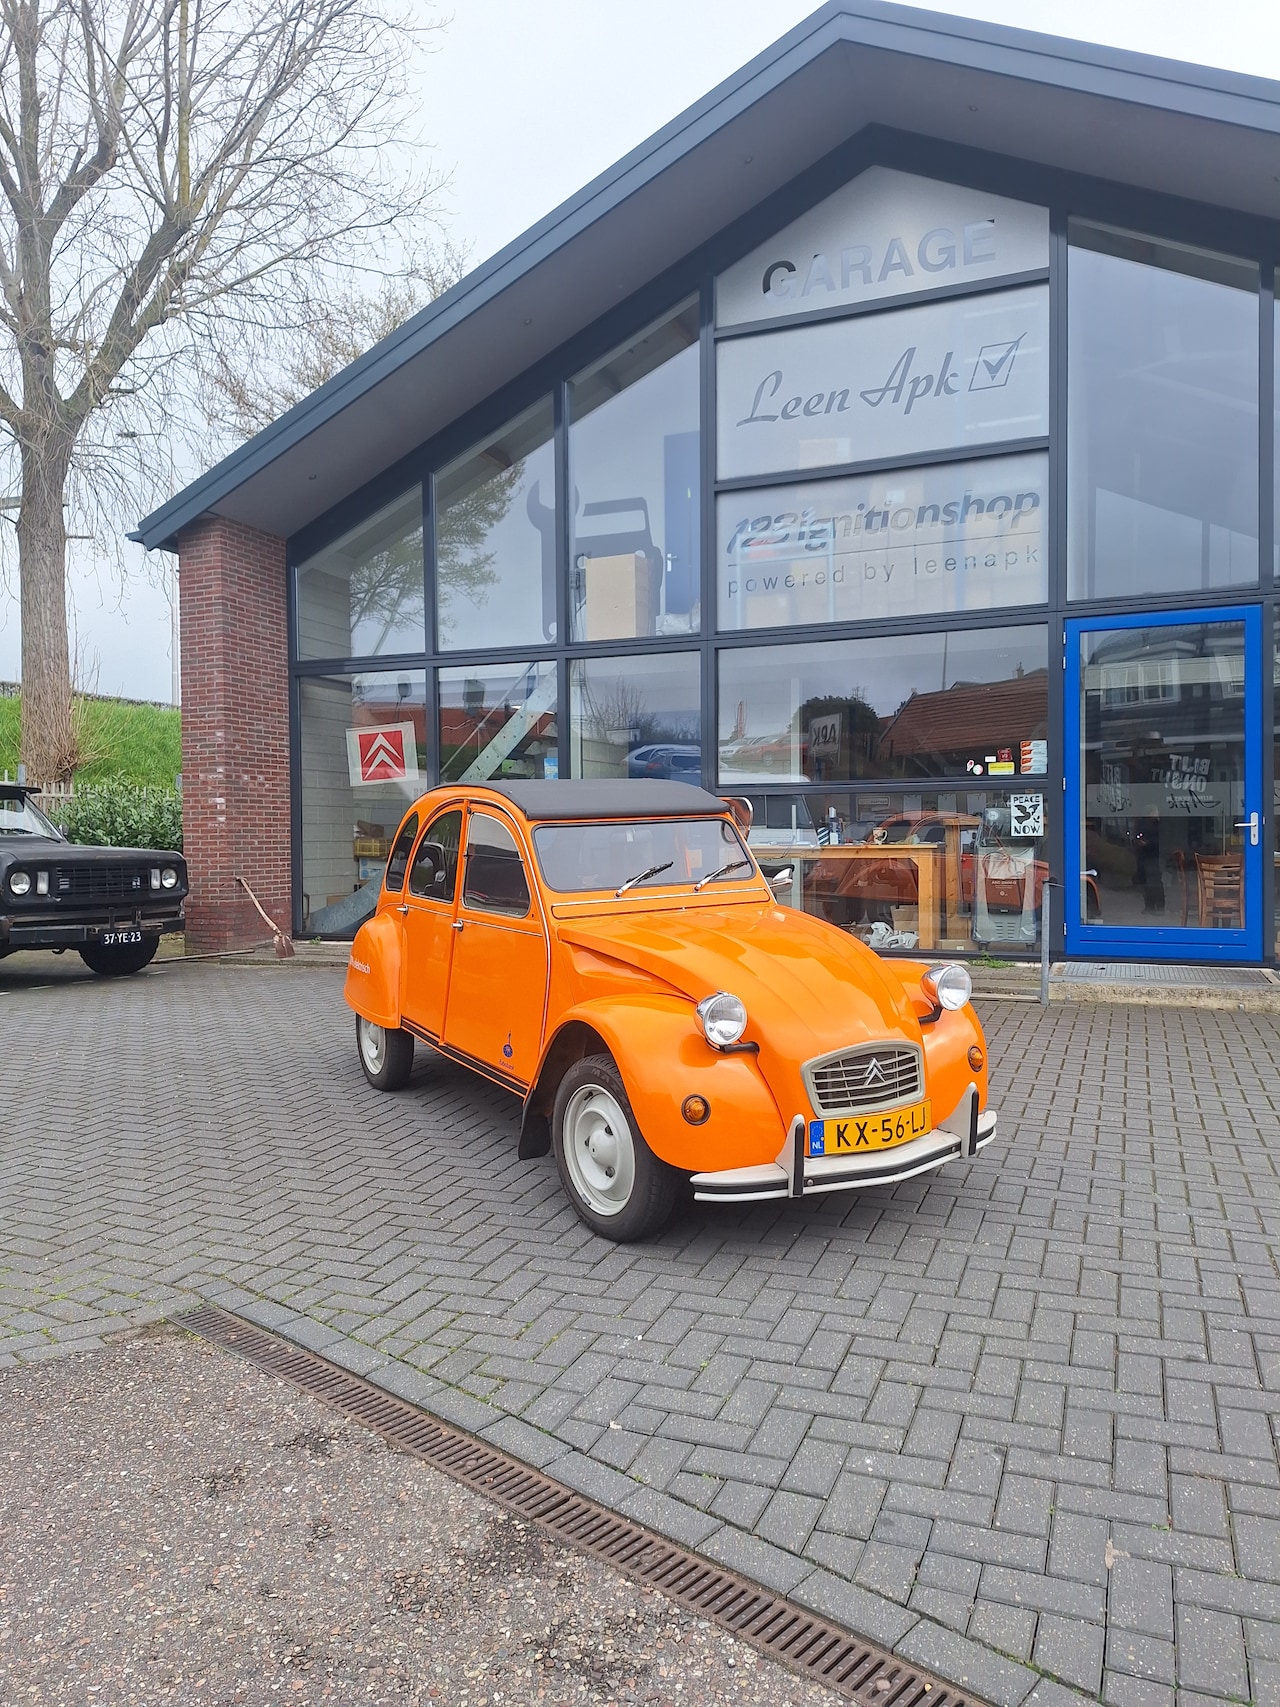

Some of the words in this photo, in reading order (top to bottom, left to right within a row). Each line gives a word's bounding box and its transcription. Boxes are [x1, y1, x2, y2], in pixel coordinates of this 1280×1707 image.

[762, 219, 997, 299] GARAGE
[736, 370, 850, 427] Leen
[859, 346, 960, 415] Apk
[728, 565, 845, 598] powered
[864, 562, 895, 583] by
[914, 545, 1038, 575] leenapk
[1013, 795, 1040, 804] PEACE
[1013, 825, 1041, 834] NOW
[812, 1141, 822, 1149] NL
[836, 1107, 926, 1147] KX-56-LJ
